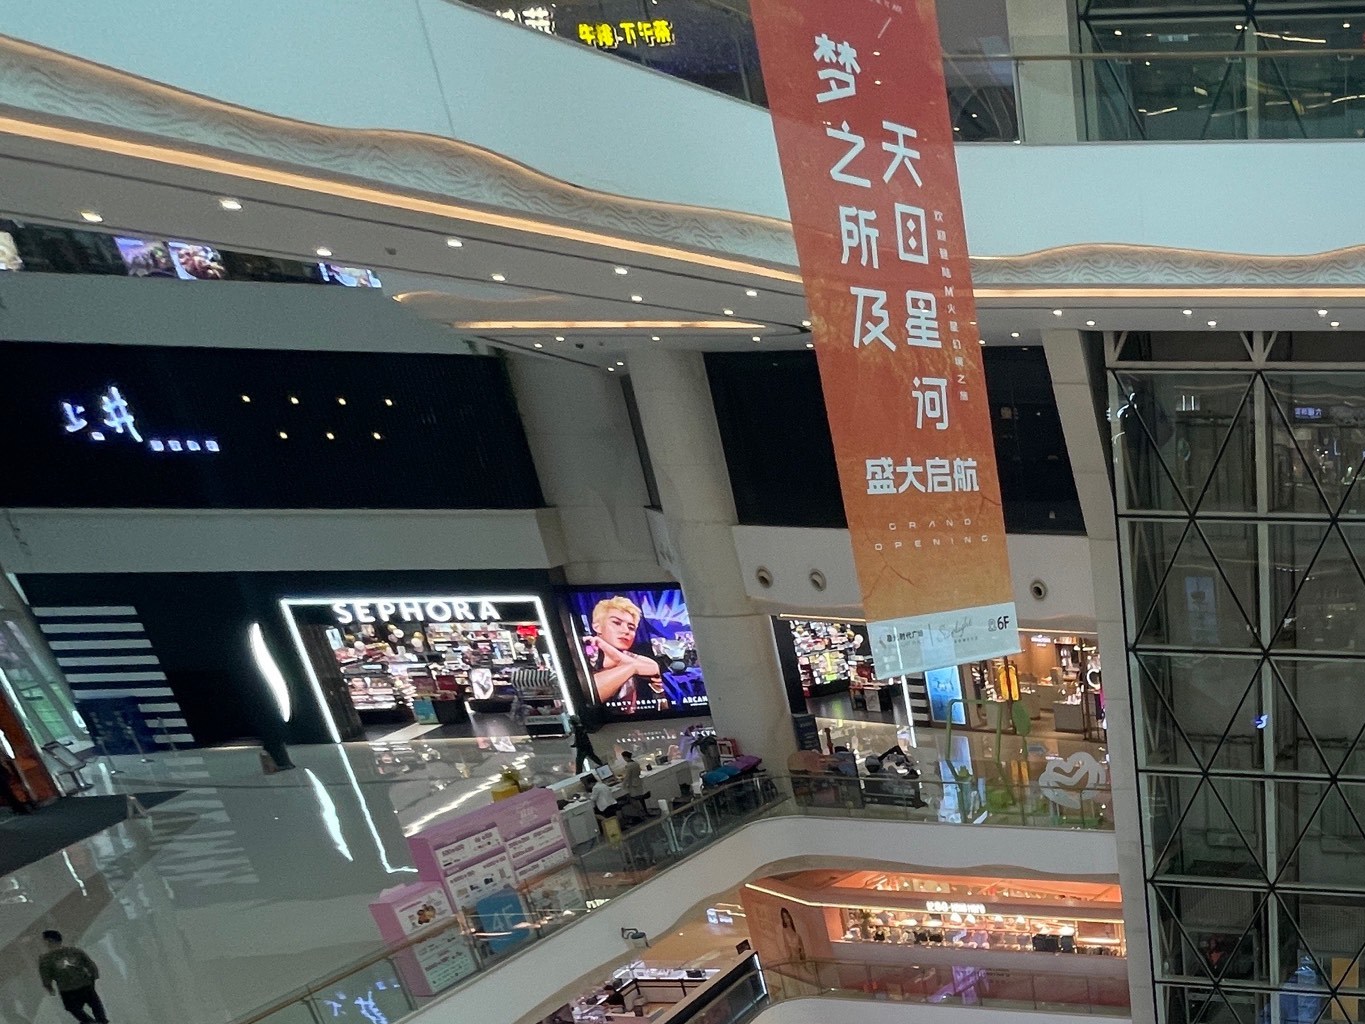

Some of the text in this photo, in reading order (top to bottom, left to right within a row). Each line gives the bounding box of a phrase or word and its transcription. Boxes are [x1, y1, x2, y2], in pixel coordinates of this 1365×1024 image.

[865, 457, 980, 494] 盛大启航
[888, 518, 972, 530] GRAND
[875, 534, 989, 551] OPENING
[332, 601, 502, 624] SEPHORA
[997, 615, 1010, 631] 6F
[492, 902, 515, 931] 4F
